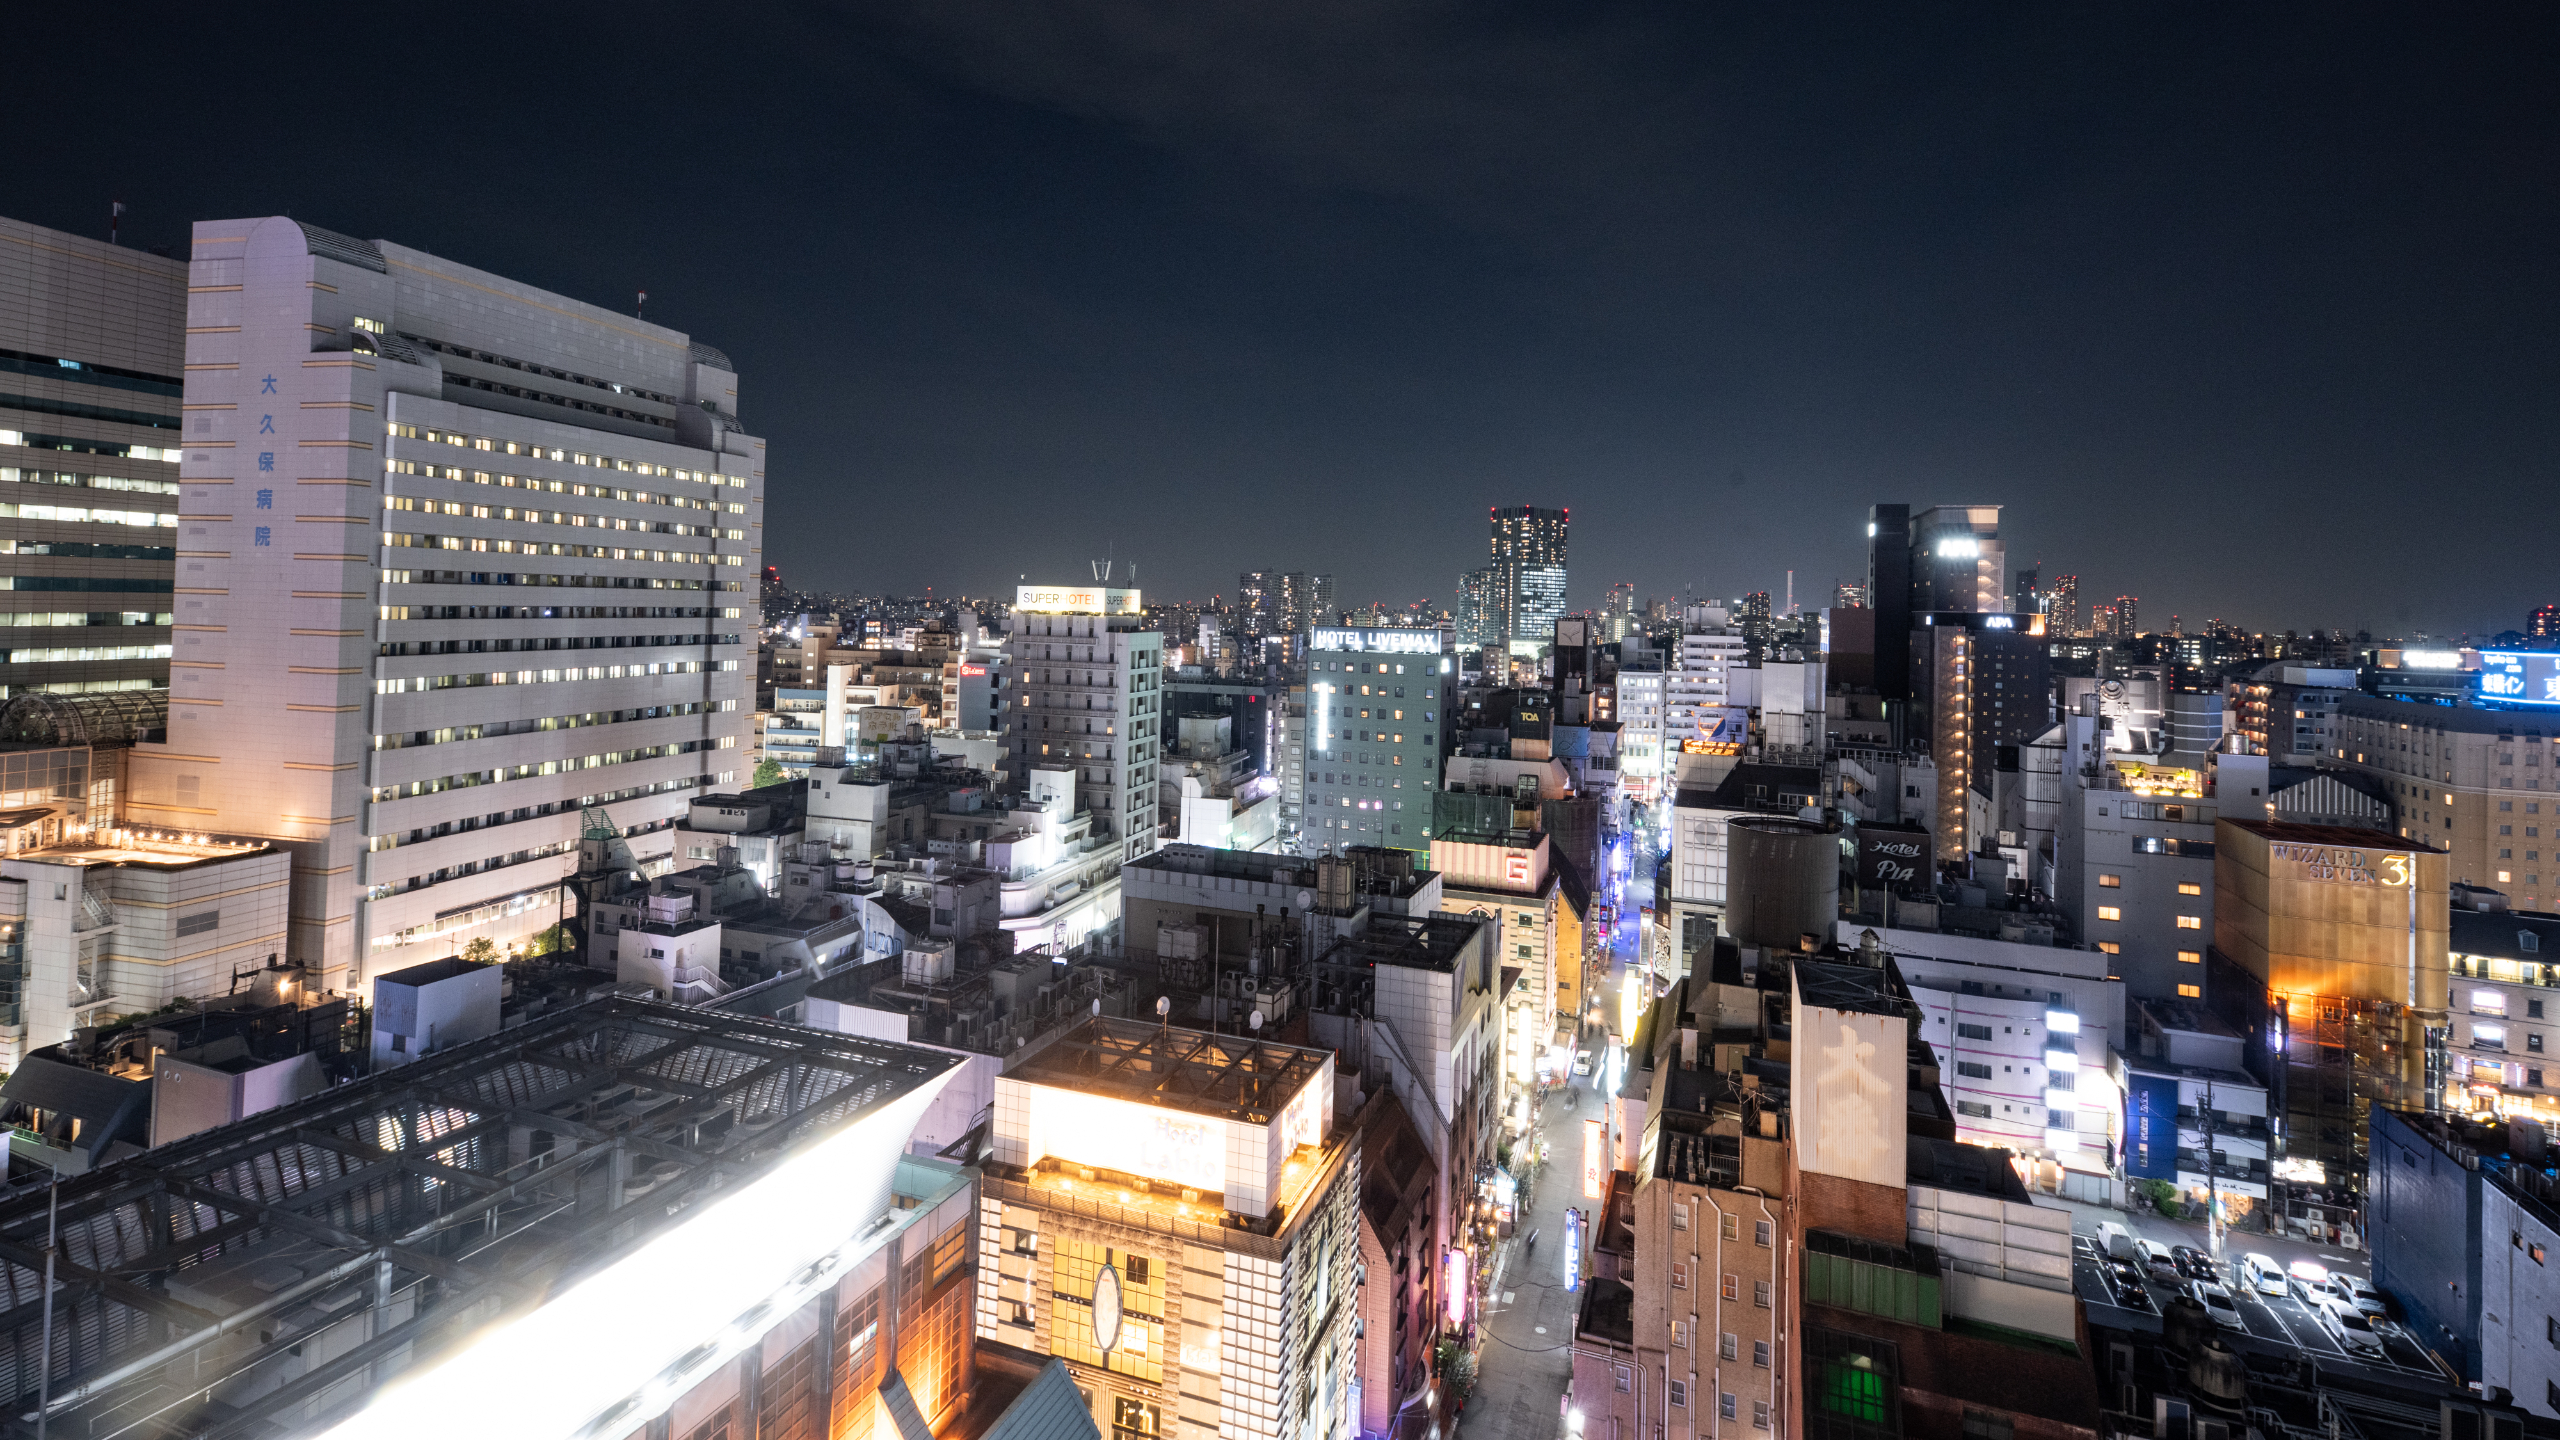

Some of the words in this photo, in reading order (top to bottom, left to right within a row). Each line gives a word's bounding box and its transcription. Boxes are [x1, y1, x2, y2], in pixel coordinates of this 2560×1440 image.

[254, 374, 277, 547] 大久保病院
[1986, 617, 2013, 628] APA
[1316, 631, 1363, 645] HOTEL
[1367, 632, 1435, 648] LIVEMAX
[2482, 674, 2524, 694] 東横イン
[864, 711, 902, 722] カプセル
[1520, 711, 1540, 722] TOA
[867, 721, 898, 732] ホテル
[1869, 841, 1921, 858] Hotel
[2271, 844, 2366, 867] WIZARD
[2309, 865, 2377, 883] SEVEN
[2381, 854, 2409, 886] 3
[1155, 1118, 1205, 1146] Hotel
[1140, 1141, 1216, 1179] Labio
